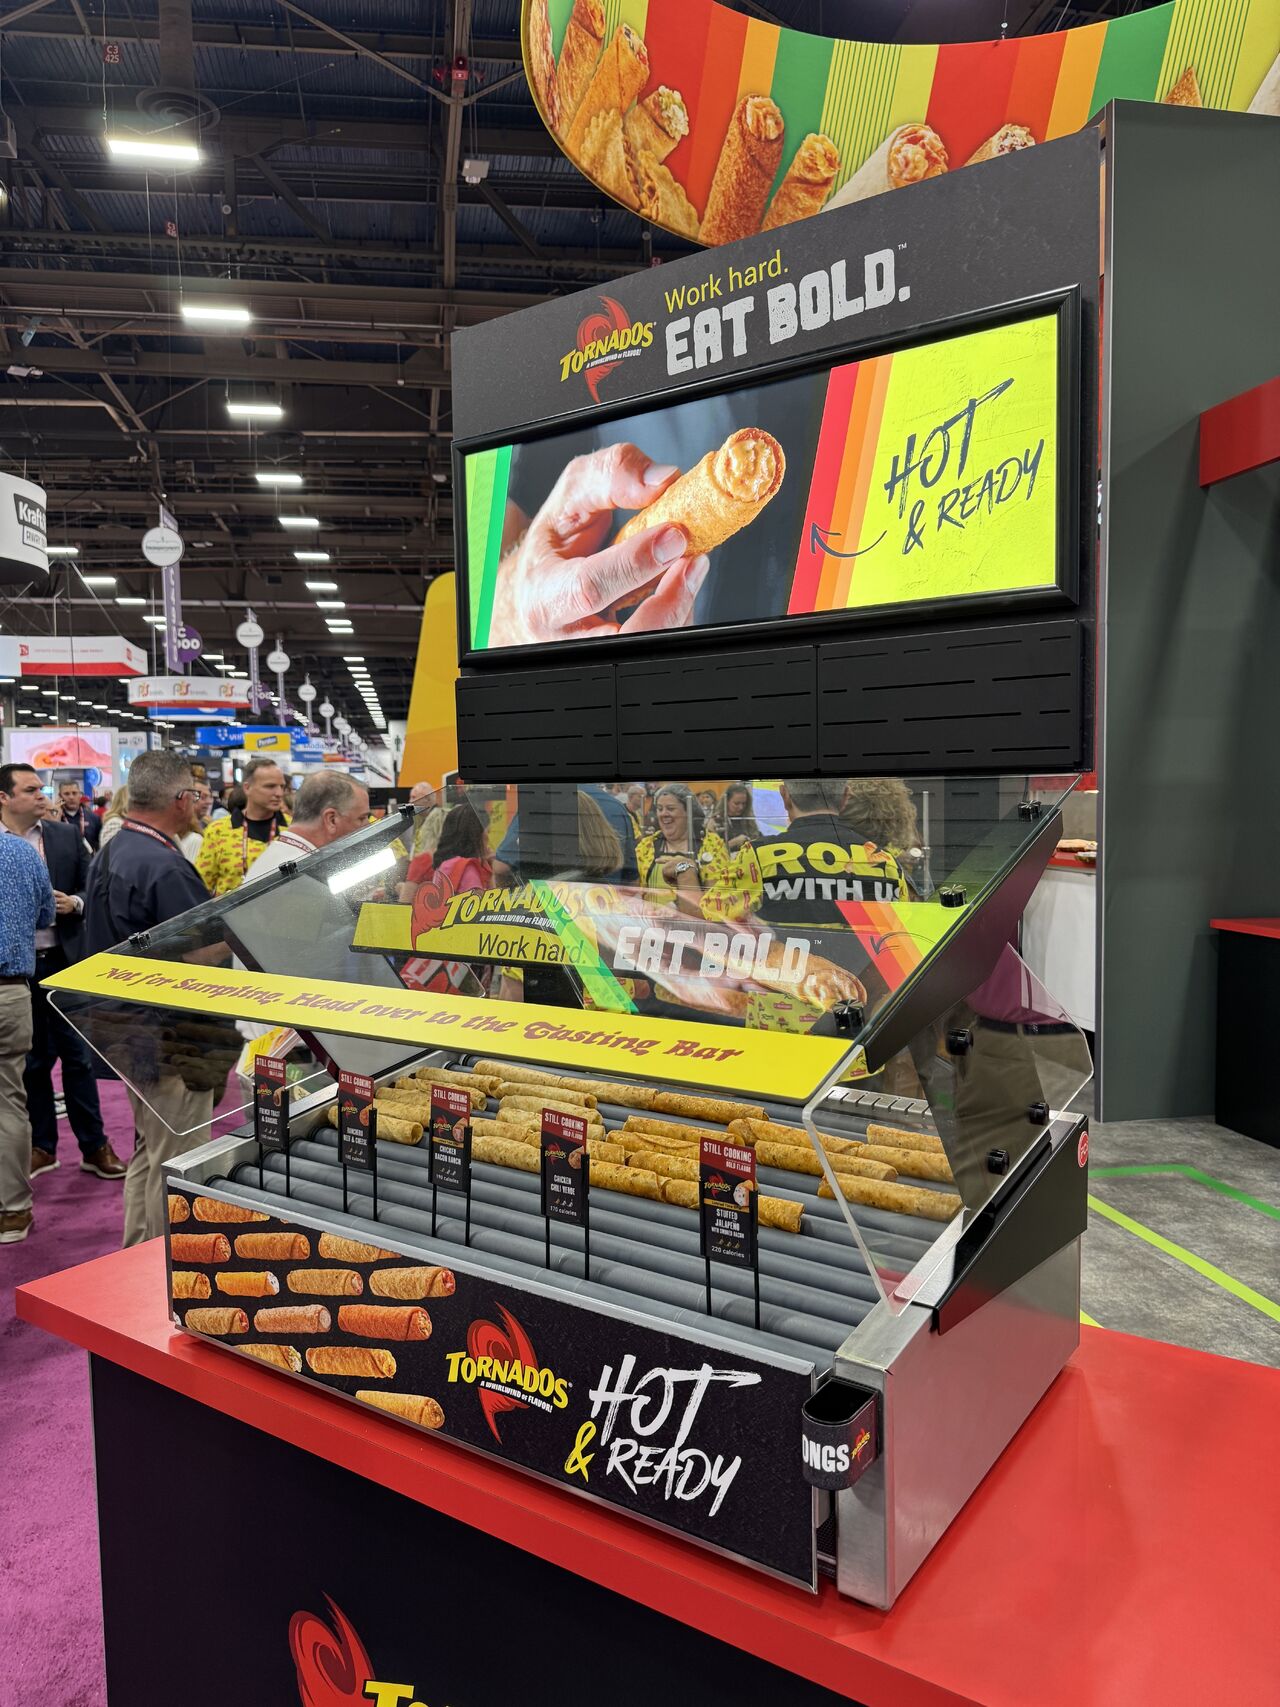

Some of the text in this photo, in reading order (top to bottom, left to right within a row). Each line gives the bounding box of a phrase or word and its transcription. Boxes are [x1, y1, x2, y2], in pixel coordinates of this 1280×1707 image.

[664, 249, 789, 314] Work hard.
[665, 248, 911, 376] EAT BOLD.
[559, 321, 655, 382] TORNADOS
[884, 377, 1015, 519] HOT
[902, 438, 1044, 555] & READY
[440, 882, 580, 929] TORNADOS
[763, 878, 864, 901] WITH
[479, 933, 586, 964] Work hard.
[613, 926, 696, 976] EAT
[96, 967, 142, 983] Not
[127, 972, 178, 987] for
[285, 993, 368, 1013] Head
[360, 1004, 428, 1020] over
[425, 1011, 462, 1025] to
[461, 1015, 519, 1033] the
[523, 1021, 661, 1056] Tasting
[664, 1039, 745, 1062] Bar
[341, 1073, 352, 1084] STILL
[433, 1088, 468, 1104] STILL COOKING
[544, 1112, 584, 1131] STILL COOKING
[703, 1141, 752, 1163] STILL COOKING
[553, 1174, 571, 1185] CHICKEN
[716, 1208, 738, 1220] STUFFED
[711, 1245, 745, 1258] 220 calories
[446, 1351, 569, 1409] TORNADOS
[485, 1381, 522, 1398] WHIRLWIND
[528, 1395, 553, 1413] FLAVOR!
[589, 1354, 762, 1447] HOT
[564, 1421, 742, 1518] & READY
